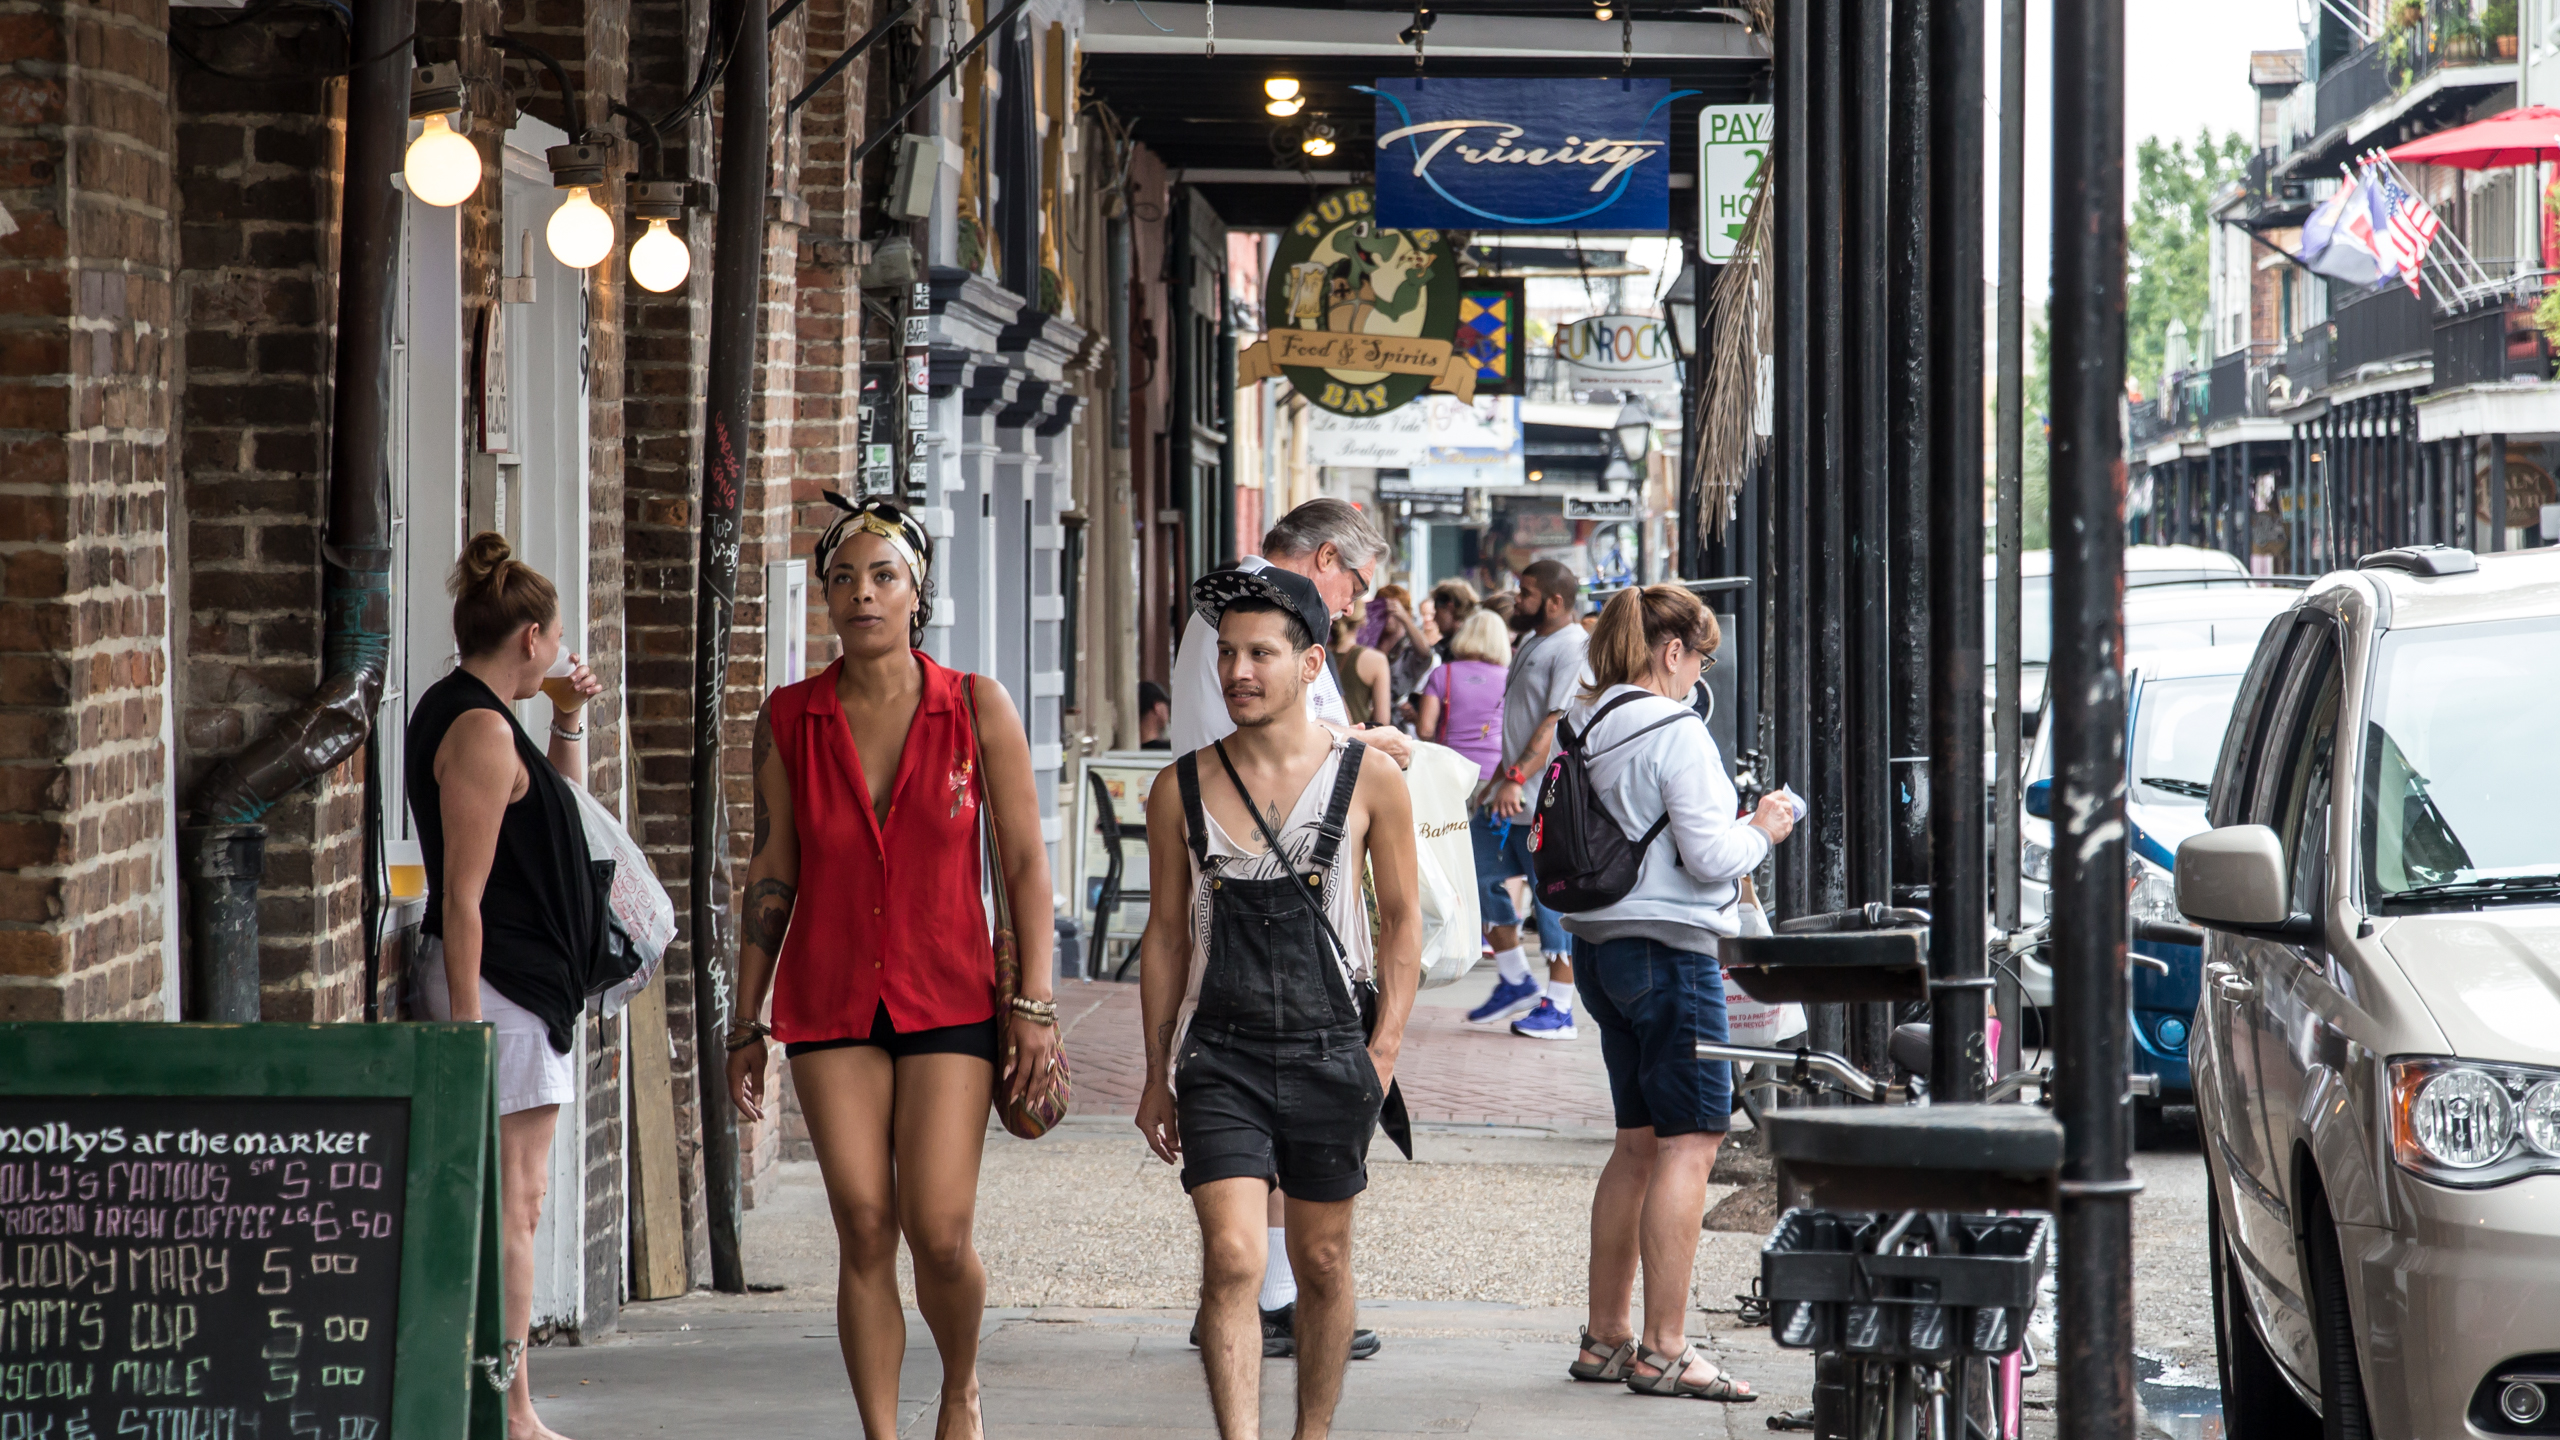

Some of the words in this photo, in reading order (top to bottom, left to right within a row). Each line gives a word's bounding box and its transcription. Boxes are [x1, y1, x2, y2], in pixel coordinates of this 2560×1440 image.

[1711, 113, 1763, 142] PAY
[1377, 119, 1665, 192] Trinity
[1743, 149, 1765, 188] 2
[1280, 335, 1337, 358] Food
[1338, 338, 1356, 365] &
[1361, 338, 1438, 368] Spirits
[1320, 383, 1388, 412] BAY
[132, 1131, 174, 1154] at
[0, 1203, 86, 1236] ROZEN
[174, 1204, 276, 1240] COFFEE
[311, 1201, 392, 1242] 6.50
[0, 1241, 118, 1295] LOODY
[129, 1243, 229, 1296] MARY
[130, 1301, 197, 1352] CUP
[112, 1356, 211, 1397] MULE
